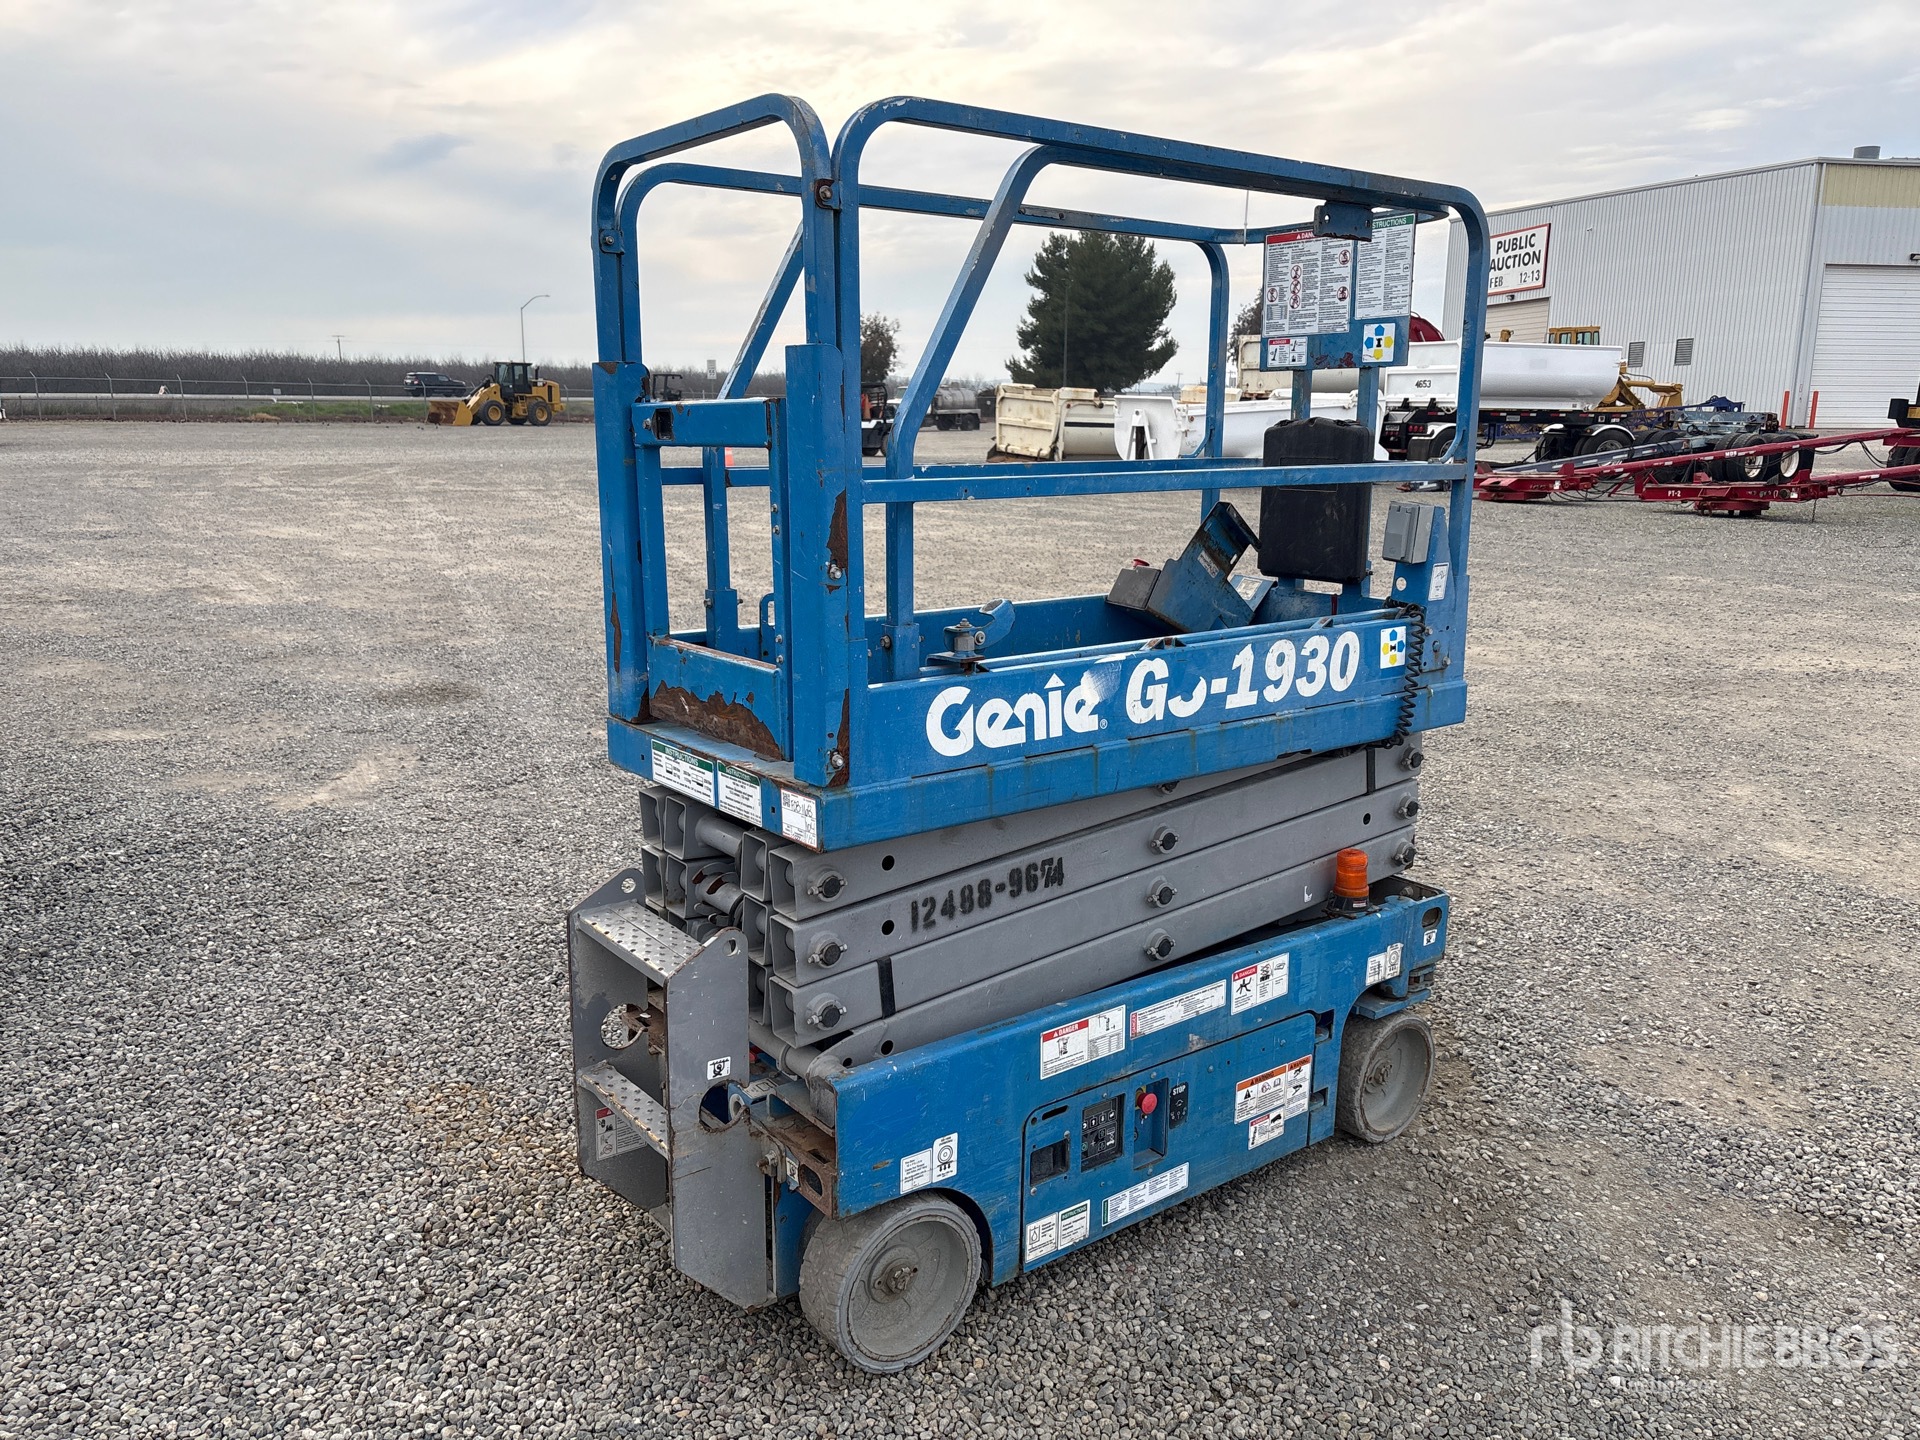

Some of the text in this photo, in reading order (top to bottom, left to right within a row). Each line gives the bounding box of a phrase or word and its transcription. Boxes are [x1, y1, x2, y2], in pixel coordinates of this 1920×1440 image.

[1372, 217, 1407, 229] STRUCTIONS
[1496, 233, 1536, 255] PUBLIC
[1490, 249, 1541, 272] AUCTION
[1490, 269, 1541, 289] FEB 12-13
[1415, 379, 1432, 389] 4653
[1058, 1023, 1079, 1036] DANGER
[1172, 1084, 1186, 1096] STOP
[1062, 1206, 1087, 1219] INSTRUCTIONS
